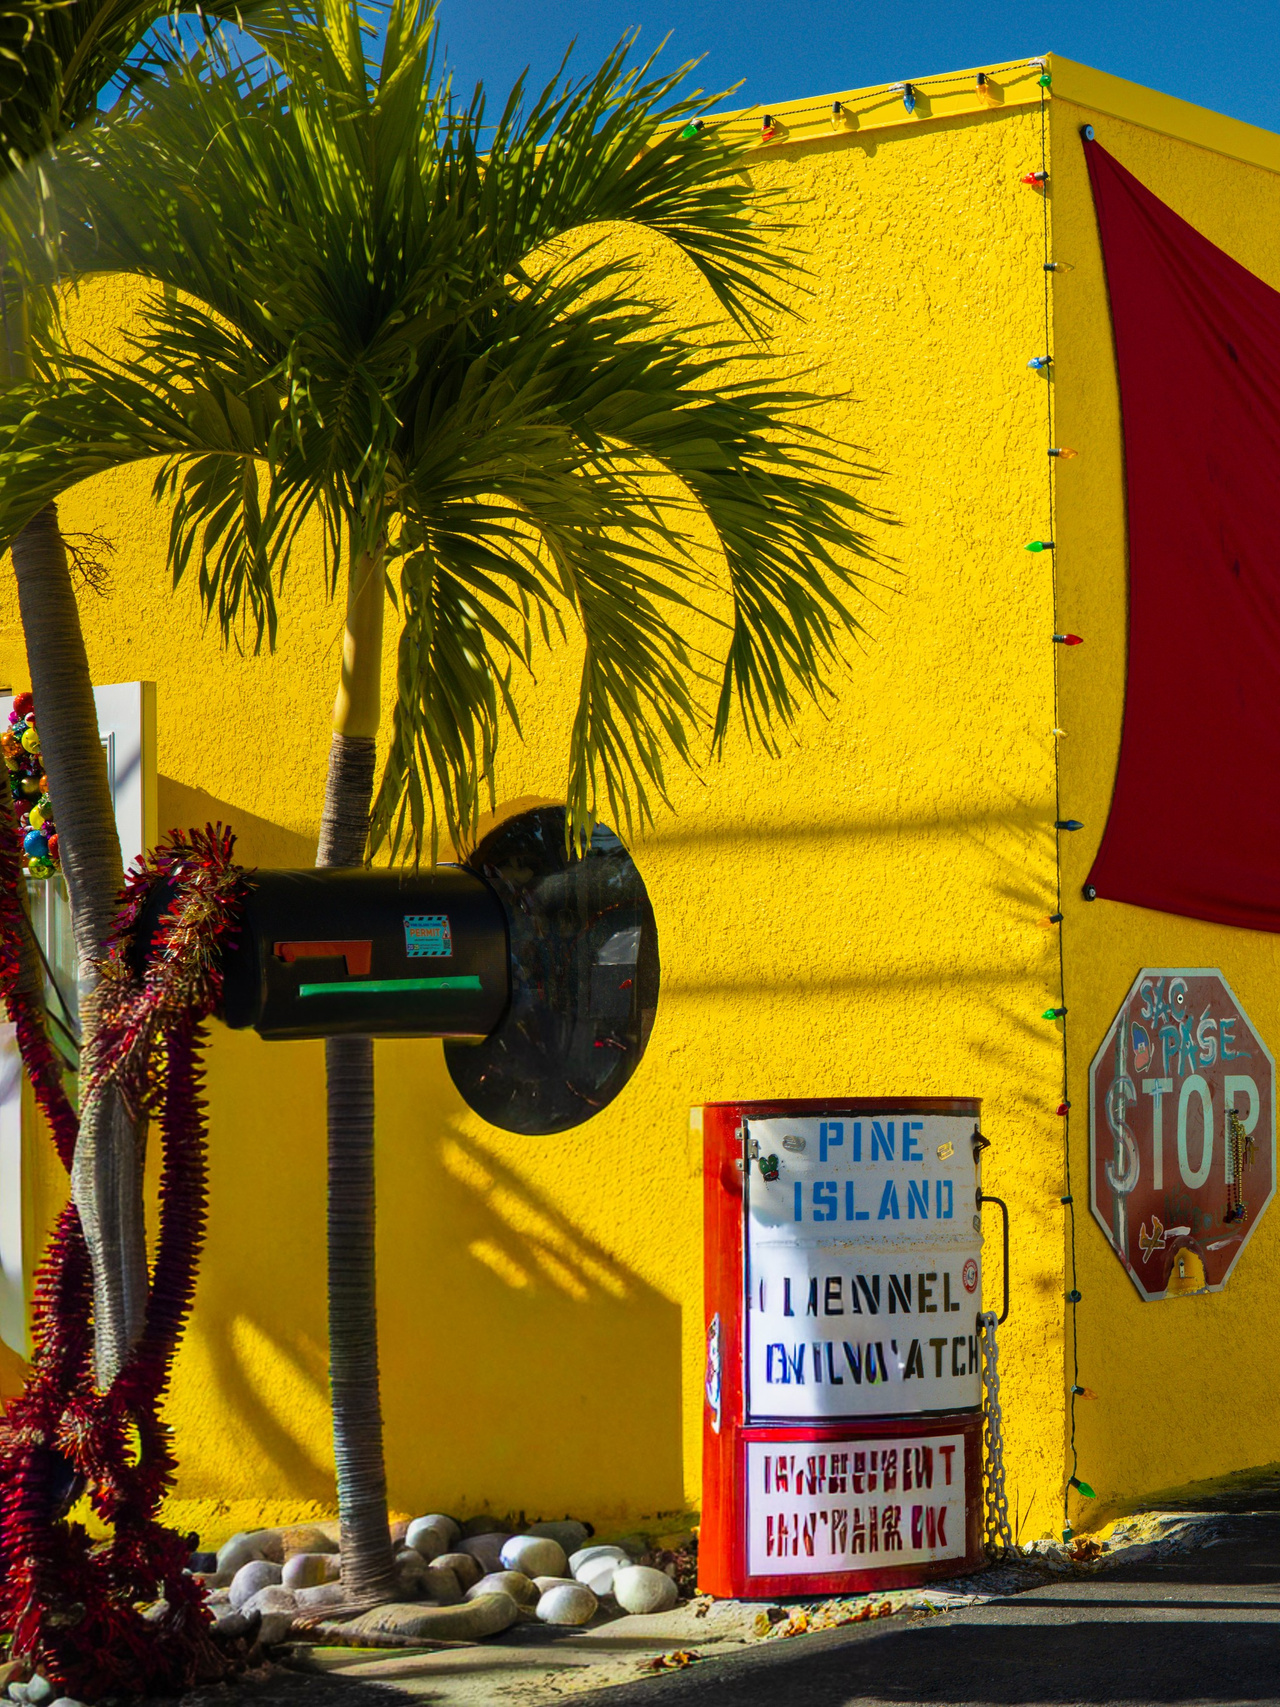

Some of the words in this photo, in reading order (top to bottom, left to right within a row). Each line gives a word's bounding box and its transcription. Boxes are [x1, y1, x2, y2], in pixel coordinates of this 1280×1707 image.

[410, 928, 440, 937] PERMIT
[819, 1121, 924, 1163] PINE
[1104, 1074, 1260, 1196] STOP
[794, 1179, 954, 1222] ISLAND
